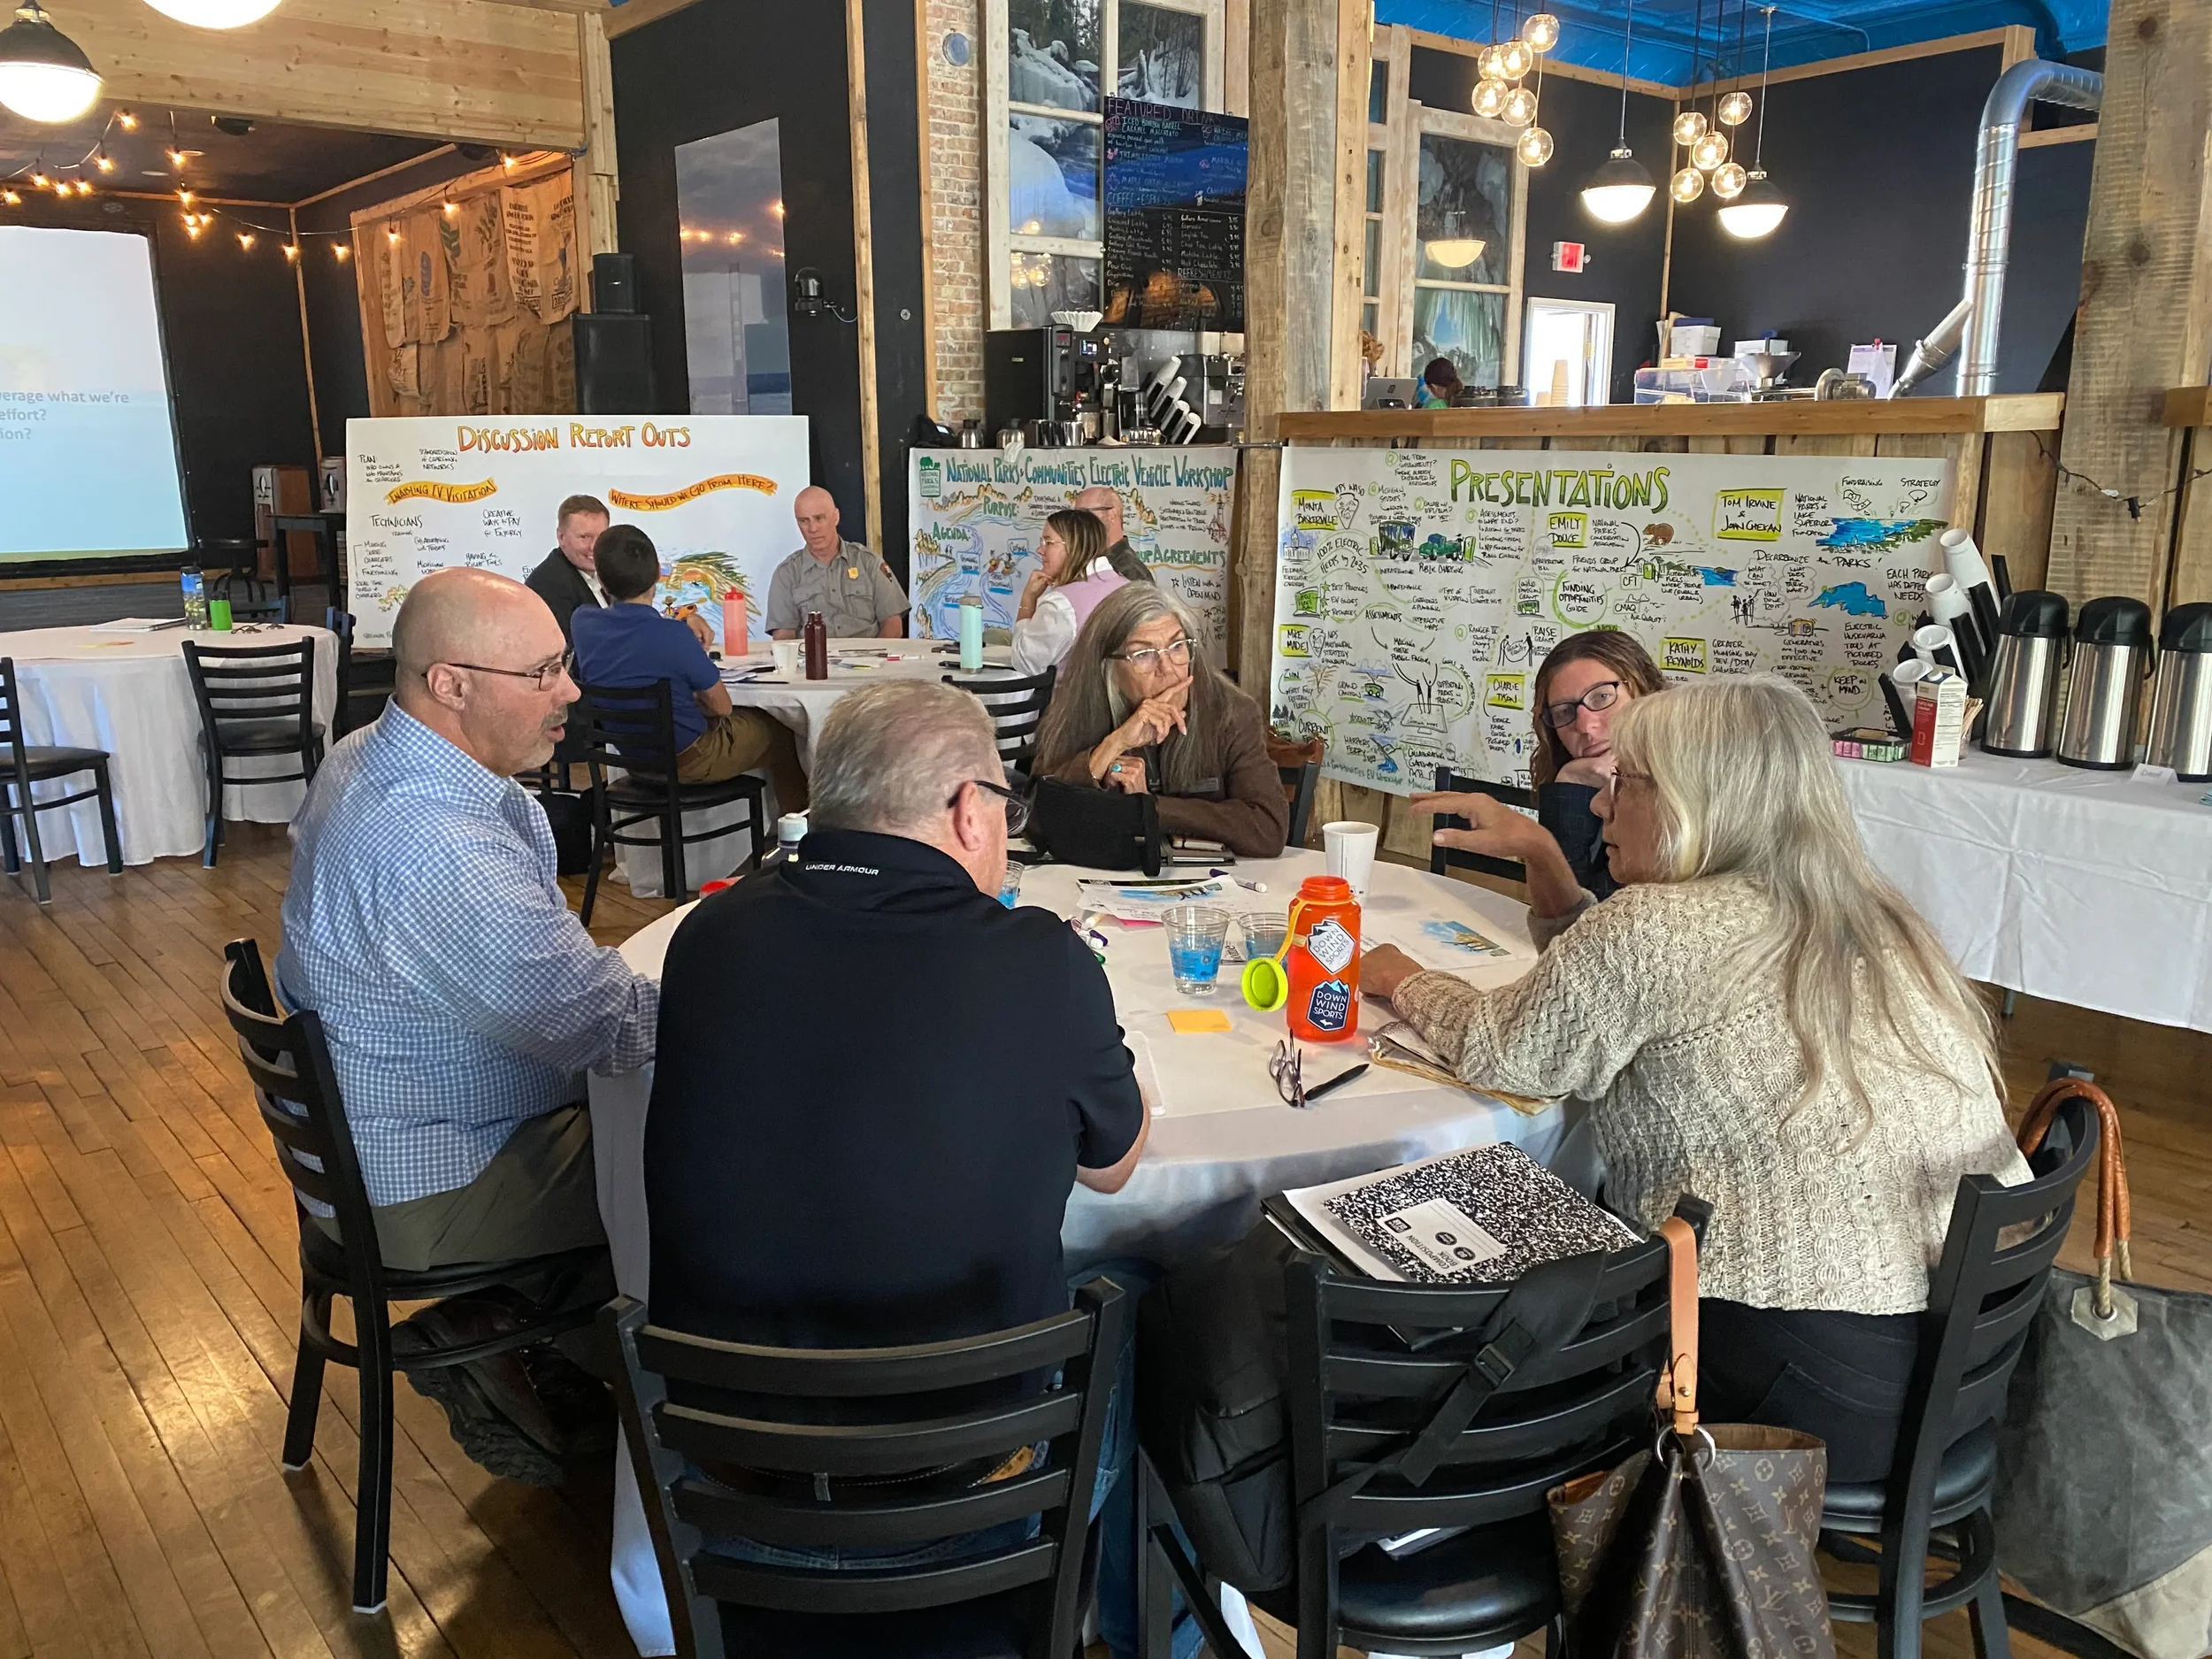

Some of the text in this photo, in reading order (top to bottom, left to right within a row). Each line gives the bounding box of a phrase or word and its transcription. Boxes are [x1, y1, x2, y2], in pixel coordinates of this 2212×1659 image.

[1108, 98, 1221, 126] FEATURED DRINKS
[1122, 125, 1146, 134] CARAMEL
[1107, 192, 1134, 205] COFFEE
[1177, 267, 1233, 281] REFRESHMENTS
[0, 390, 129, 404] erage what we're
[0, 408, 47, 421] effort?
[570, 422, 636, 448] REPORT
[641, 422, 691, 448] OUTS
[1413, 454, 1427, 464] TERM
[946, 454, 1234, 492] NATIONAL PARKS COMMUNITIES ELECTRIC VEHICLE WORKSHOP
[1841, 476, 1883, 487] FUNDRAISING
[1900, 478, 1941, 488] STRATEGY
[389, 485, 429, 504] ENABLING
[446, 482, 496, 503] VISITATION
[611, 475, 775, 511] WHERE SHOULD WE GO FROM HERE?
[1794, 494, 1827, 503] NATIONAL
[1298, 496, 1325, 513] MONTA
[1721, 495, 1777, 510] TOM IRVINE
[371, 514, 423, 529] TECHNICIANS
[1549, 516, 1581, 530] EMILY
[1592, 518, 1619, 527] NATIONAL
[1745, 519, 1782, 534] CHEKAN
[494, 527, 522, 538] ENERGY
[932, 521, 972, 542] AGENDA:
[1548, 533, 1580, 544] DOUCE
[1153, 543, 1226, 568] AGREEMENTS
[1317, 538, 1363, 562] 100% ELECTRIC
[1572, 555, 1597, 565] FRIENDS
[1753, 549, 1810, 564] DECARBONIZE
[1832, 556, 1871, 568] PARKS
[1349, 555, 1370, 578] 2035
[1418, 562, 1463, 575] PUBLIC CHARGING
[1622, 575, 1638, 587] CFI
[1887, 569, 1934, 580] EACH PARK
[1562, 580, 1595, 595] FUNDING
[1887, 580, 1904, 589] HAS
[1187, 588, 1204, 599] OPEN
[1893, 592, 1925, 603] NEEDS
[1558, 593, 1605, 609] OPPORTUNITIES
[1565, 603, 1589, 613] GUIDE
[1614, 603, 1637, 617] CMAQ
[1365, 609, 1402, 623] ASSESSMENTS
[1469, 625, 1491, 636] RANGER
[1533, 626, 1557, 637] RAISE
[1845, 622, 1882, 632] ELECTRIC
[1286, 640, 1310, 654] MADEJ
[1670, 641, 1698, 656] KATHY
[1712, 638, 1746, 649] GREATER
[1868, 641, 1882, 650] AT
[1844, 650, 1883, 659] PICTURED
[1664, 655, 1704, 671] REYNOLDS
[1851, 659, 1879, 670] ROCKS
[1338, 680, 1358, 690] GRAND
[1493, 679, 1519, 692] CHARLIE
[1833, 675, 1858, 687] KEEP
[1496, 694, 1517, 704] TYSON
[1298, 718, 1333, 735] CURRENT
[836, 864, 879, 876] ARMOUR
[1313, 926, 1339, 954] DOWN
[1318, 932, 1344, 959] WIND
[1325, 938, 1350, 966] SPORTS
[1316, 991, 1348, 1006] DOWN
[1316, 999, 1346, 1011] WIND
[1313, 1009, 1344, 1020] SPORTS
[1406, 1233, 1450, 1270] COMPOSITION
[1437, 1250, 1459, 1267] BOOK
